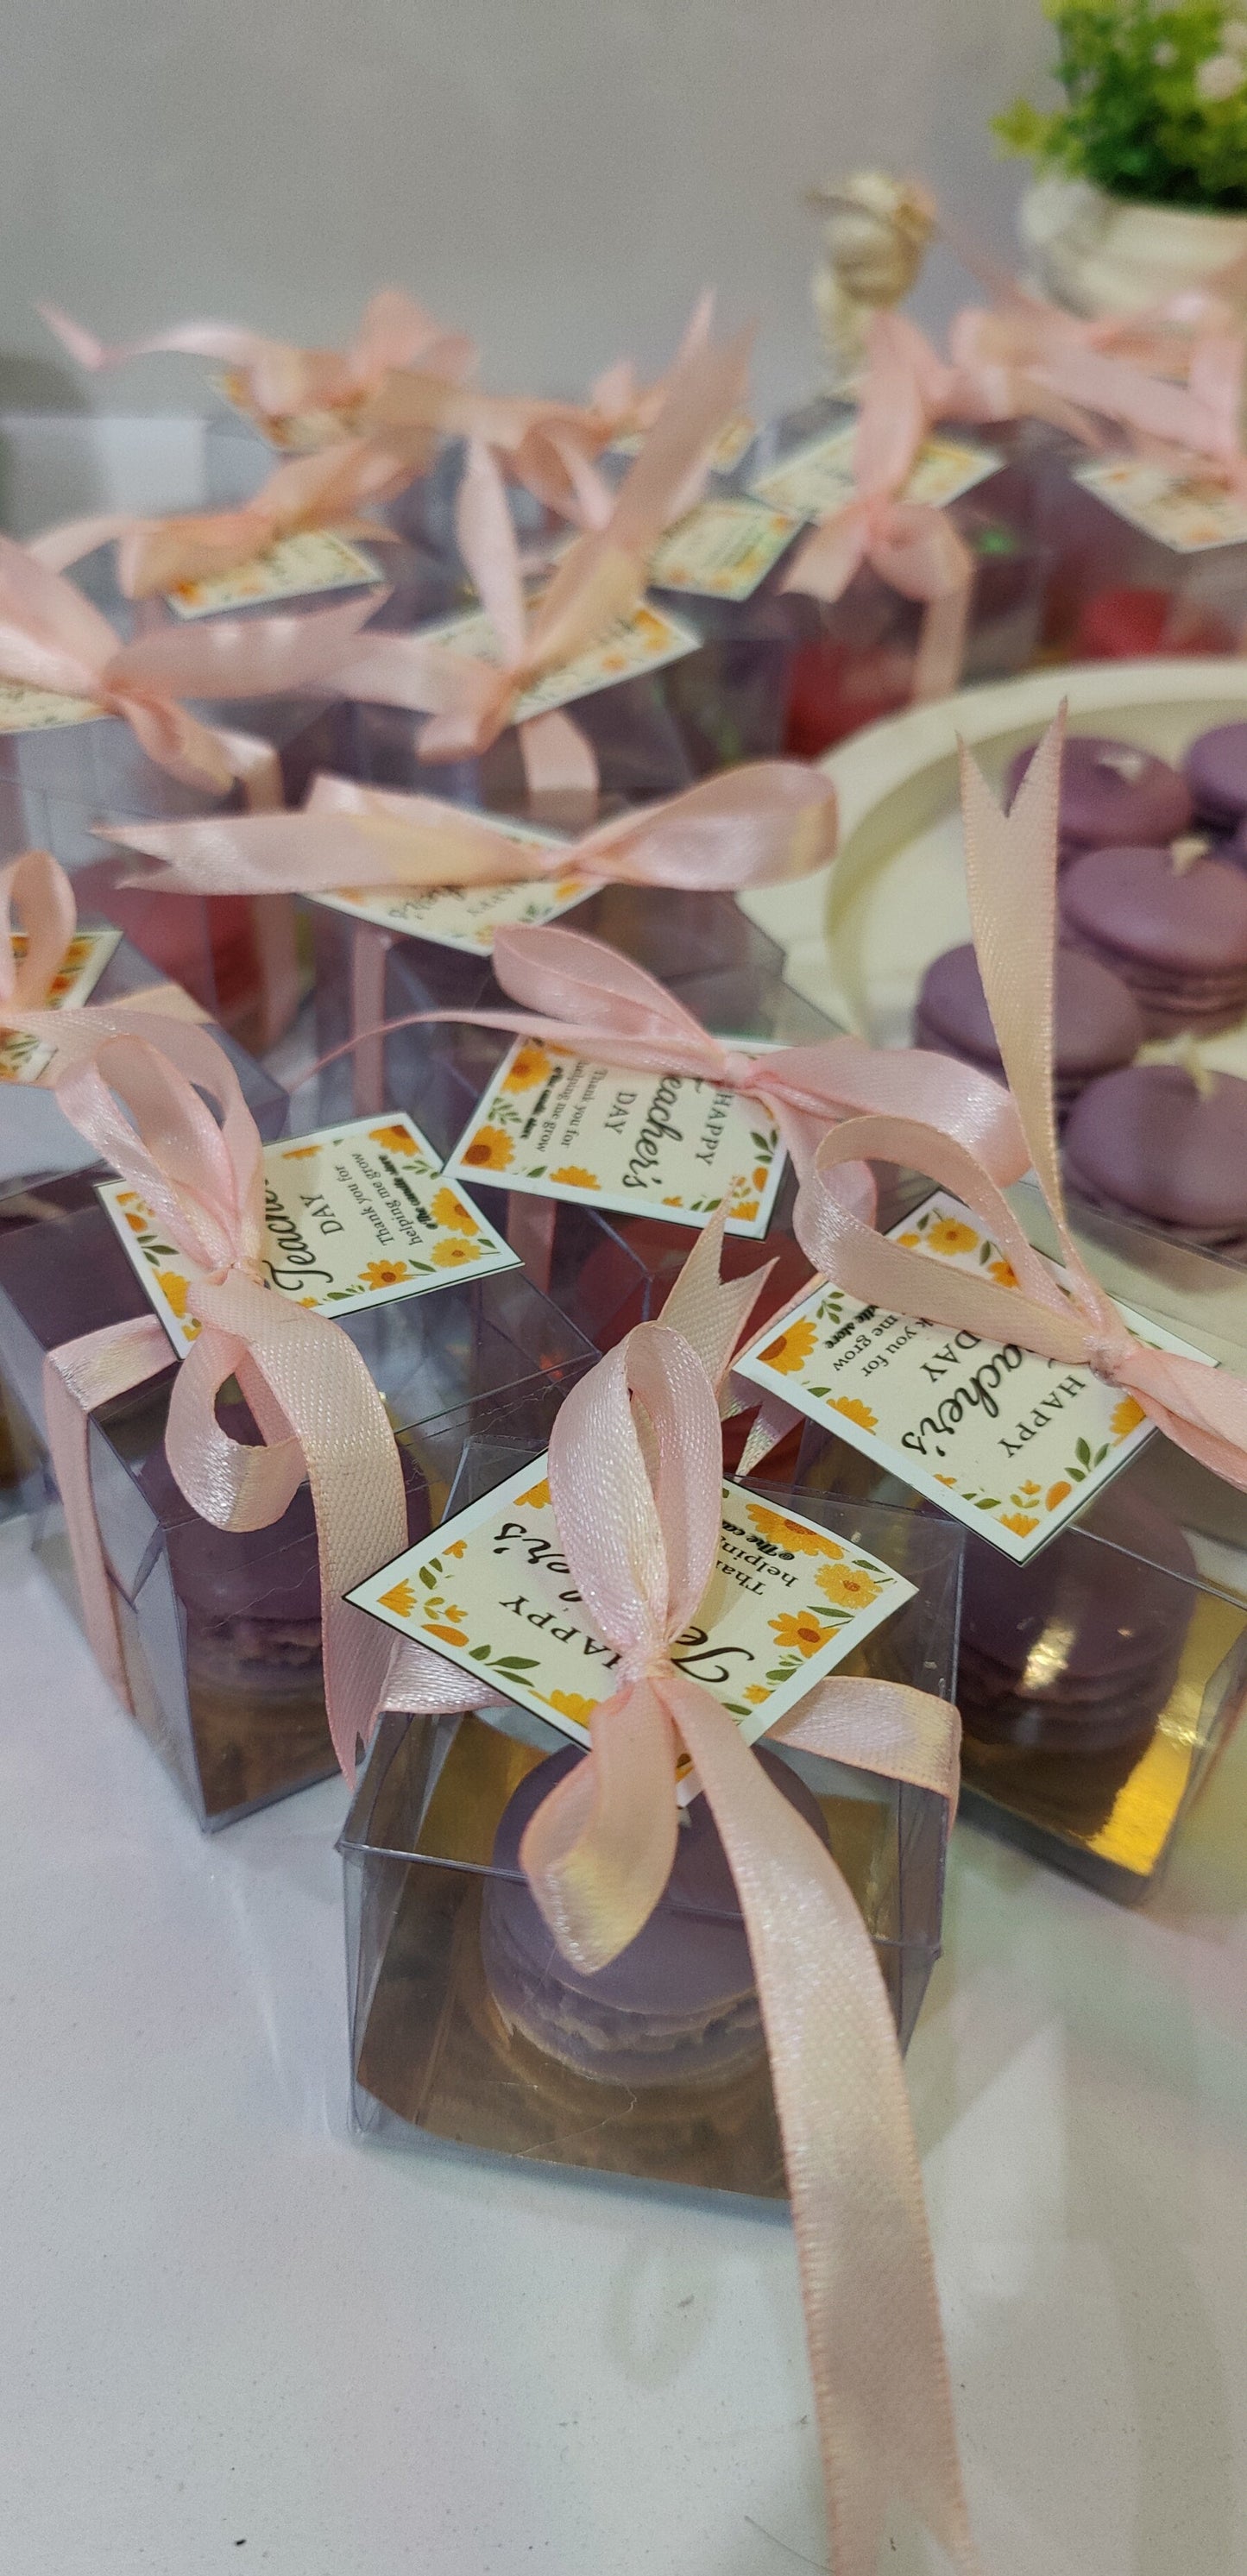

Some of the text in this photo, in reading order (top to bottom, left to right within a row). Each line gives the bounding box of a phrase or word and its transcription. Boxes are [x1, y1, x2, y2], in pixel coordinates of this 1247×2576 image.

[536, 1121, 557, 1152] grow
[552, 1103, 566, 1119] me
[570, 1105, 588, 1125] you
[604, 1092, 638, 1135] DAY
[622, 1075, 702, 1188] eacher's
[696, 1092, 735, 1166] HAPPY
[561, 1130, 580, 1148] for
[299, 1194, 344, 1236] DAY
[335, 1165, 395, 1246] Thank you for
[352, 1153, 424, 1245] helping me grow
[833, 1314, 898, 1371] me grow
[861, 1325, 917, 1376] you for
[919, 1329, 981, 1382] DAY
[901, 1343, 1036, 1457] acher's
[997, 1375, 1086, 1458] HAPPY
[716, 1559, 766, 1596] Tha
[720, 1535, 799, 1588] helpin
